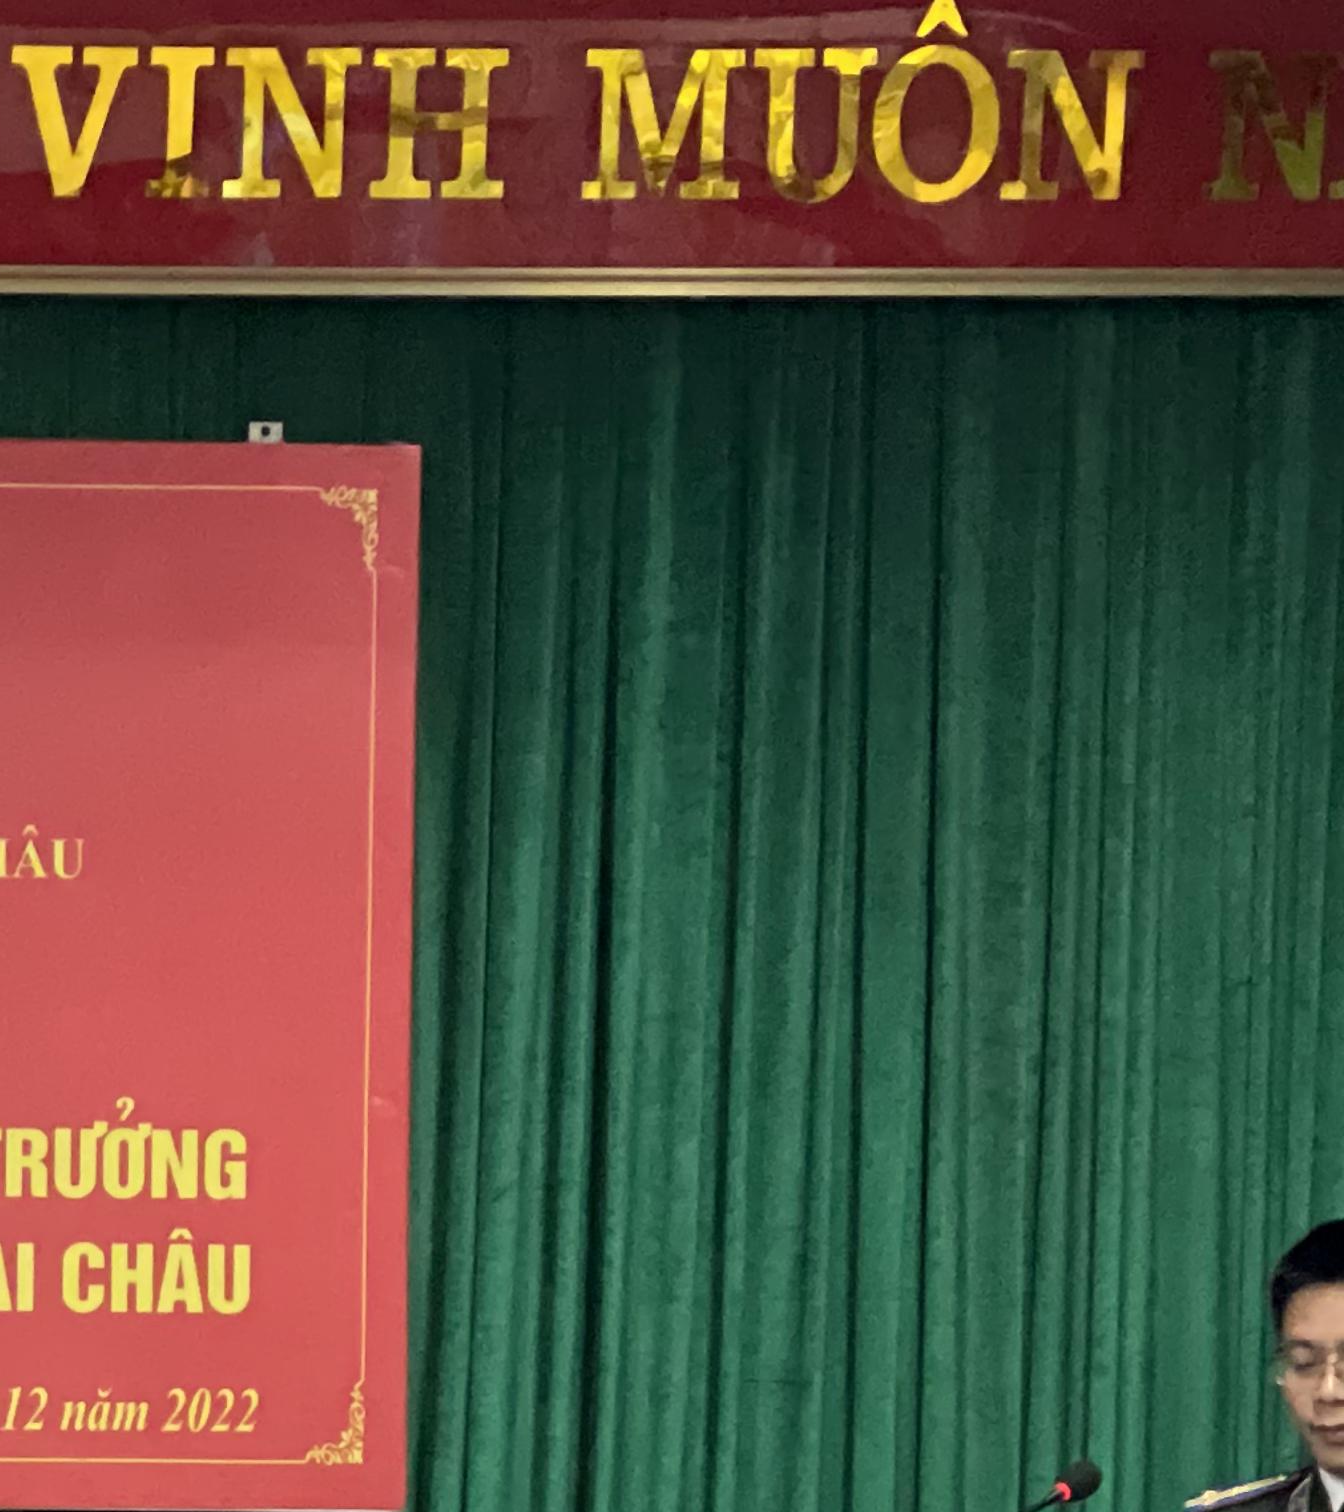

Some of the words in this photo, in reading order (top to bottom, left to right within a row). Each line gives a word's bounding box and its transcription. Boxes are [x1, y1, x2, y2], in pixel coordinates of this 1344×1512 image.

[9, 44, 512, 202] VINH
[577, 0, 1147, 204] MUÔN
[62, 1228, 250, 1314] CHÂU
[2, 1387, 48, 1430] 12
[60, 1389, 148, 1431] năm
[162, 1388, 258, 1432] 2022
